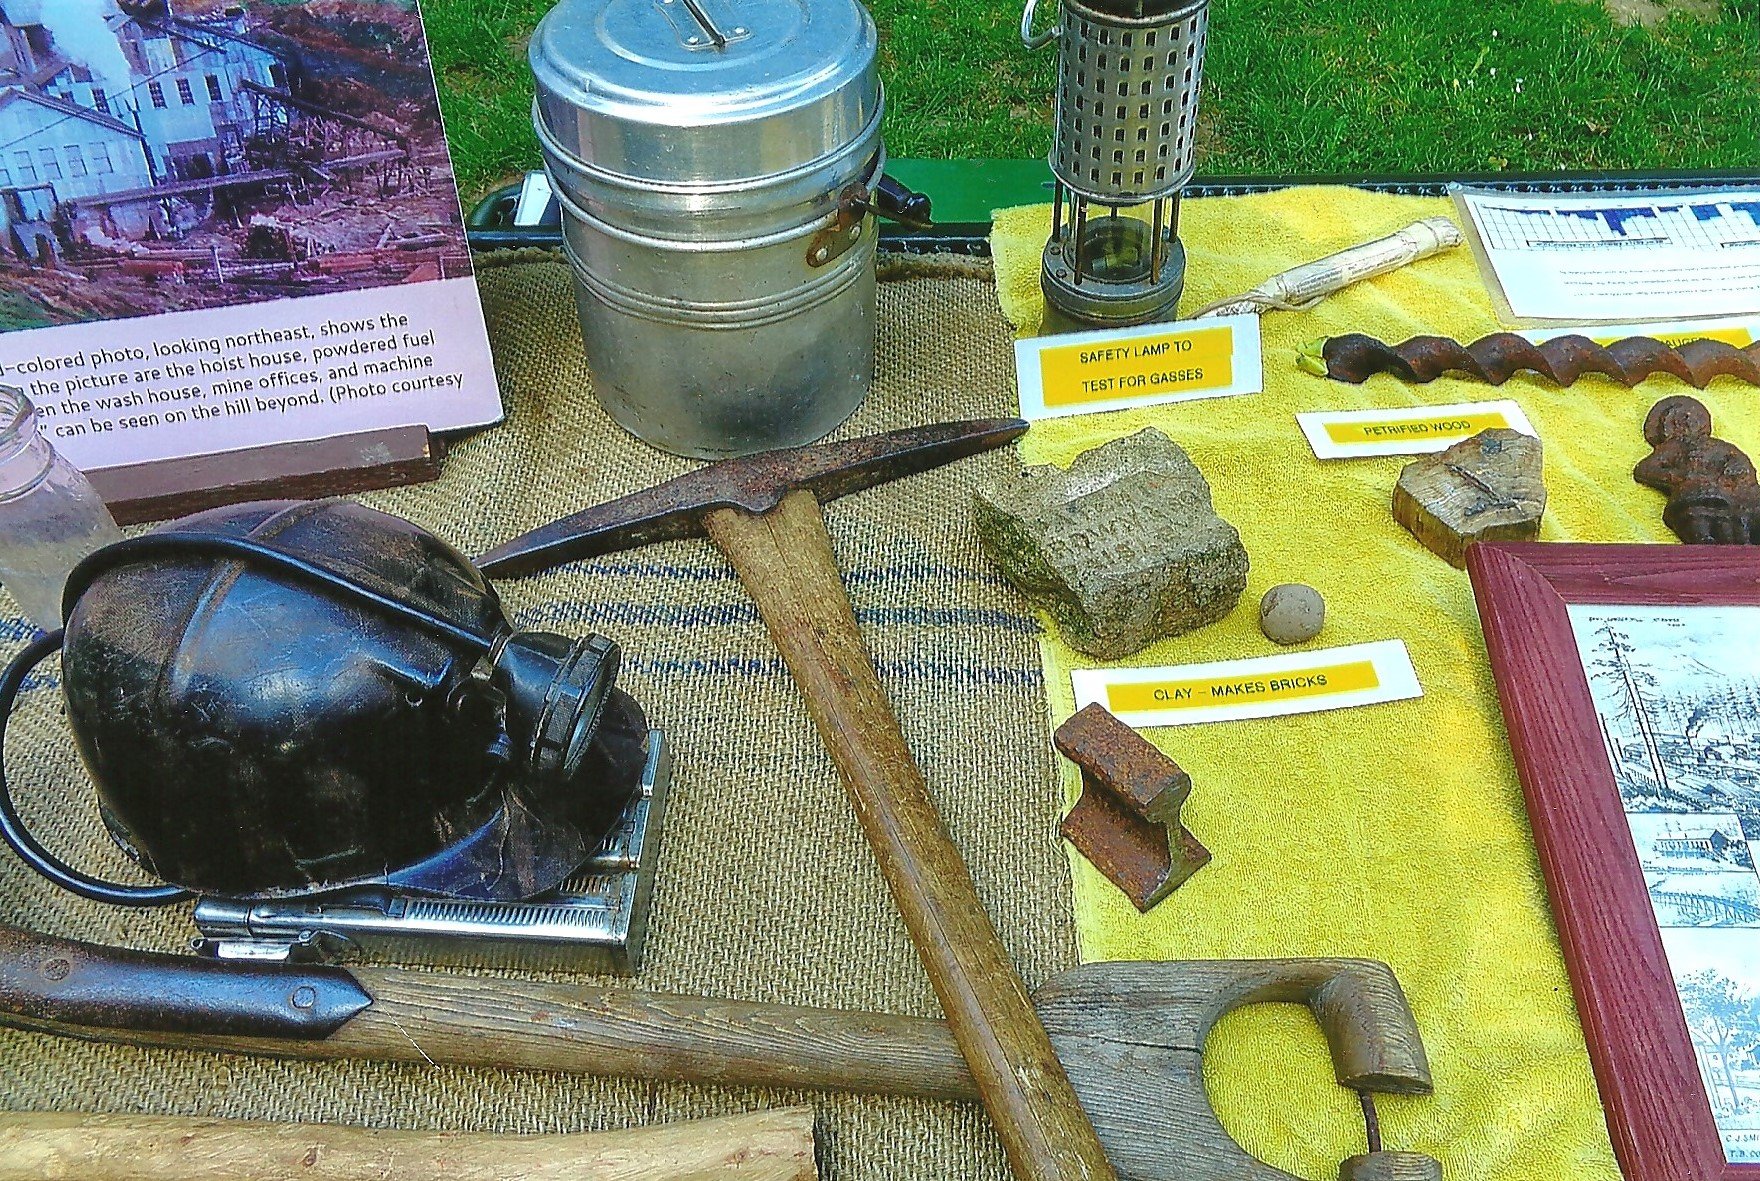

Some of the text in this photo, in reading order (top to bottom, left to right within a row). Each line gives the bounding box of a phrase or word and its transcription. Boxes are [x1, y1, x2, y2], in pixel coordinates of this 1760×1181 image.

[30, 329, 434, 396] the picture are the hoist house, powdered fuel
[91, 348, 149, 370] photo,
[153, 338, 220, 356] looking
[225, 326, 314, 349] northeast,
[321, 319, 374, 336] shows
[380, 313, 407, 328] the
[1080, 340, 1192, 364] SAFETY LAMP TO
[61, 399, 91, 414] the
[95, 391, 143, 409] wash
[147, 387, 206, 404] house,
[212, 379, 253, 395] mine
[259, 371, 322, 388] offices,
[328, 362, 358, 380] and
[364, 355, 432, 375] machine
[1082, 368, 1204, 393] TEST FOR GASSES
[56, 374, 462, 438] can be seen on the hill beyond. (Photo courtesy
[1363, 420, 1471, 436] PETRIFIED WOOD
[1154, 688, 1192, 701] CLAY
[1211, 680, 1266, 697] MAKES
[1270, 674, 1328, 692] BRICKS
